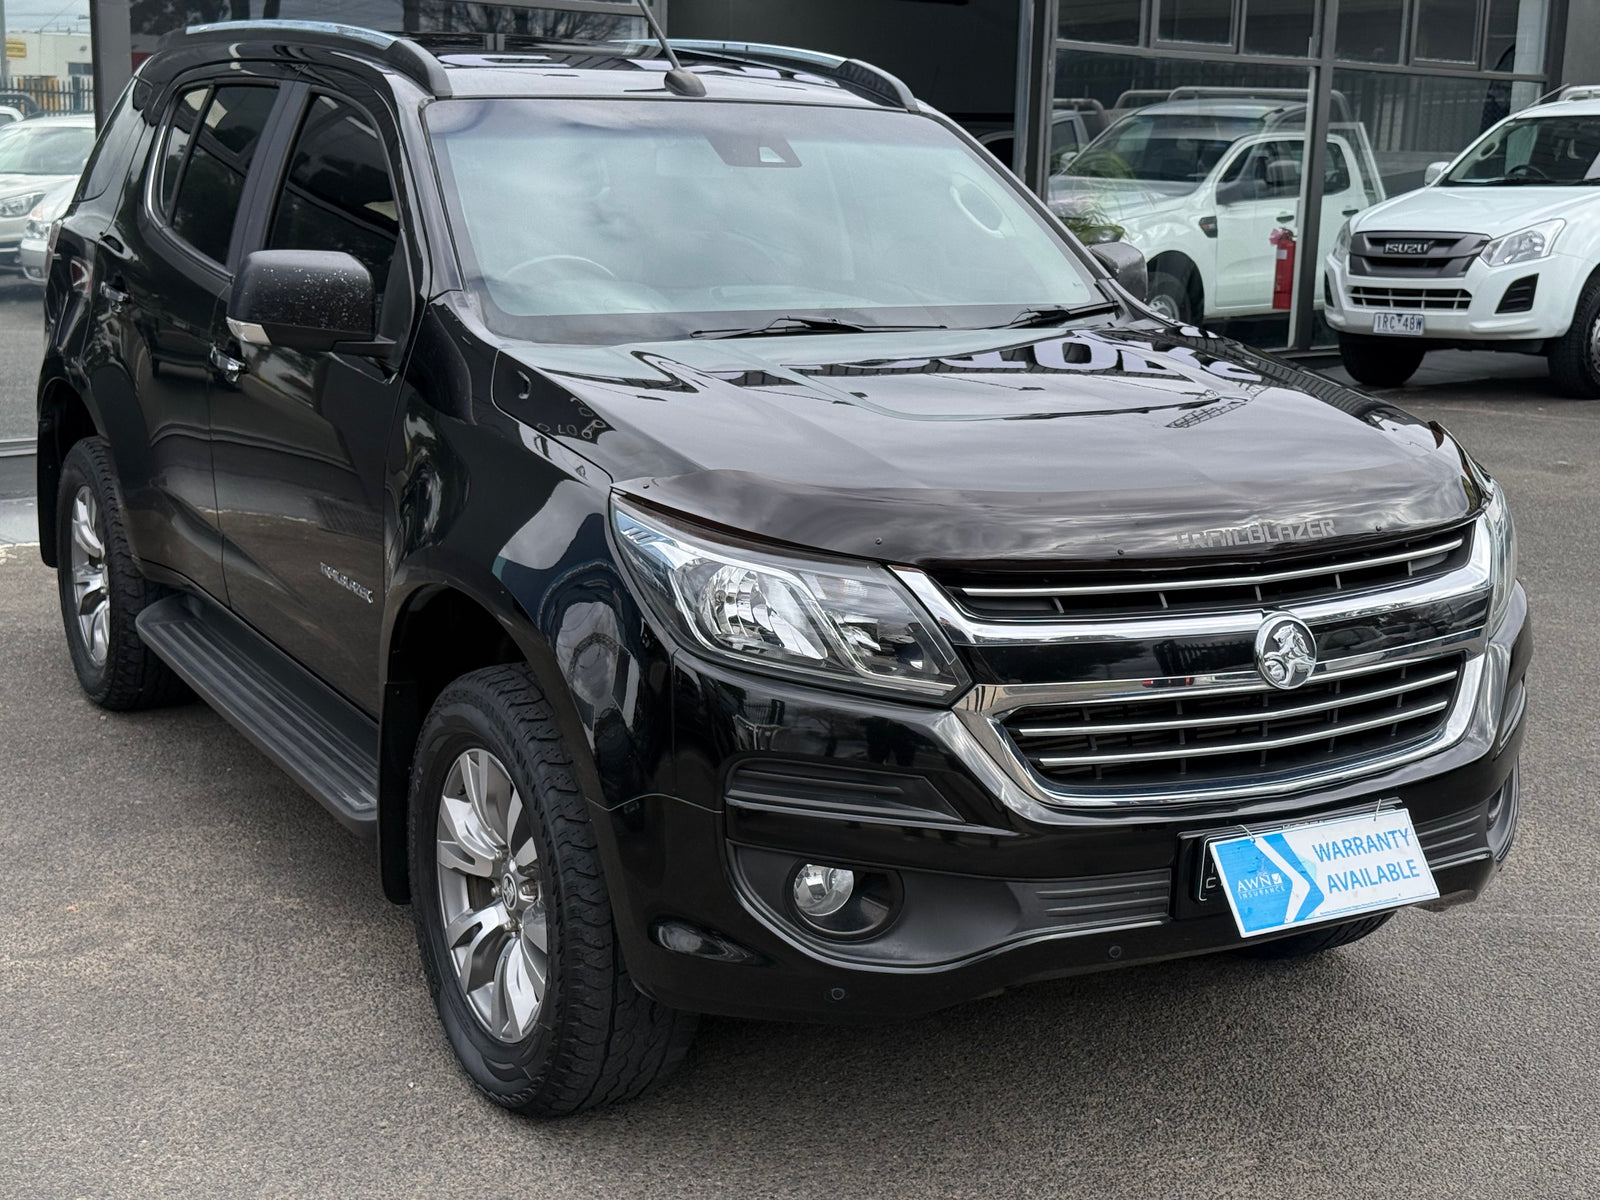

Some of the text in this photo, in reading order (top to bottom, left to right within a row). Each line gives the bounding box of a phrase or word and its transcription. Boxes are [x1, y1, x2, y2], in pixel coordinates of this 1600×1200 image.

[1384, 243, 1428, 254] ISUZU
[1377, 315, 1395, 330] 1RC
[1312, 828, 1410, 862] WARRANTY
[1237, 873, 1272, 893] AWN
[1327, 859, 1420, 894] AVAILABLE
[1238, 885, 1286, 900] INSURANCE
